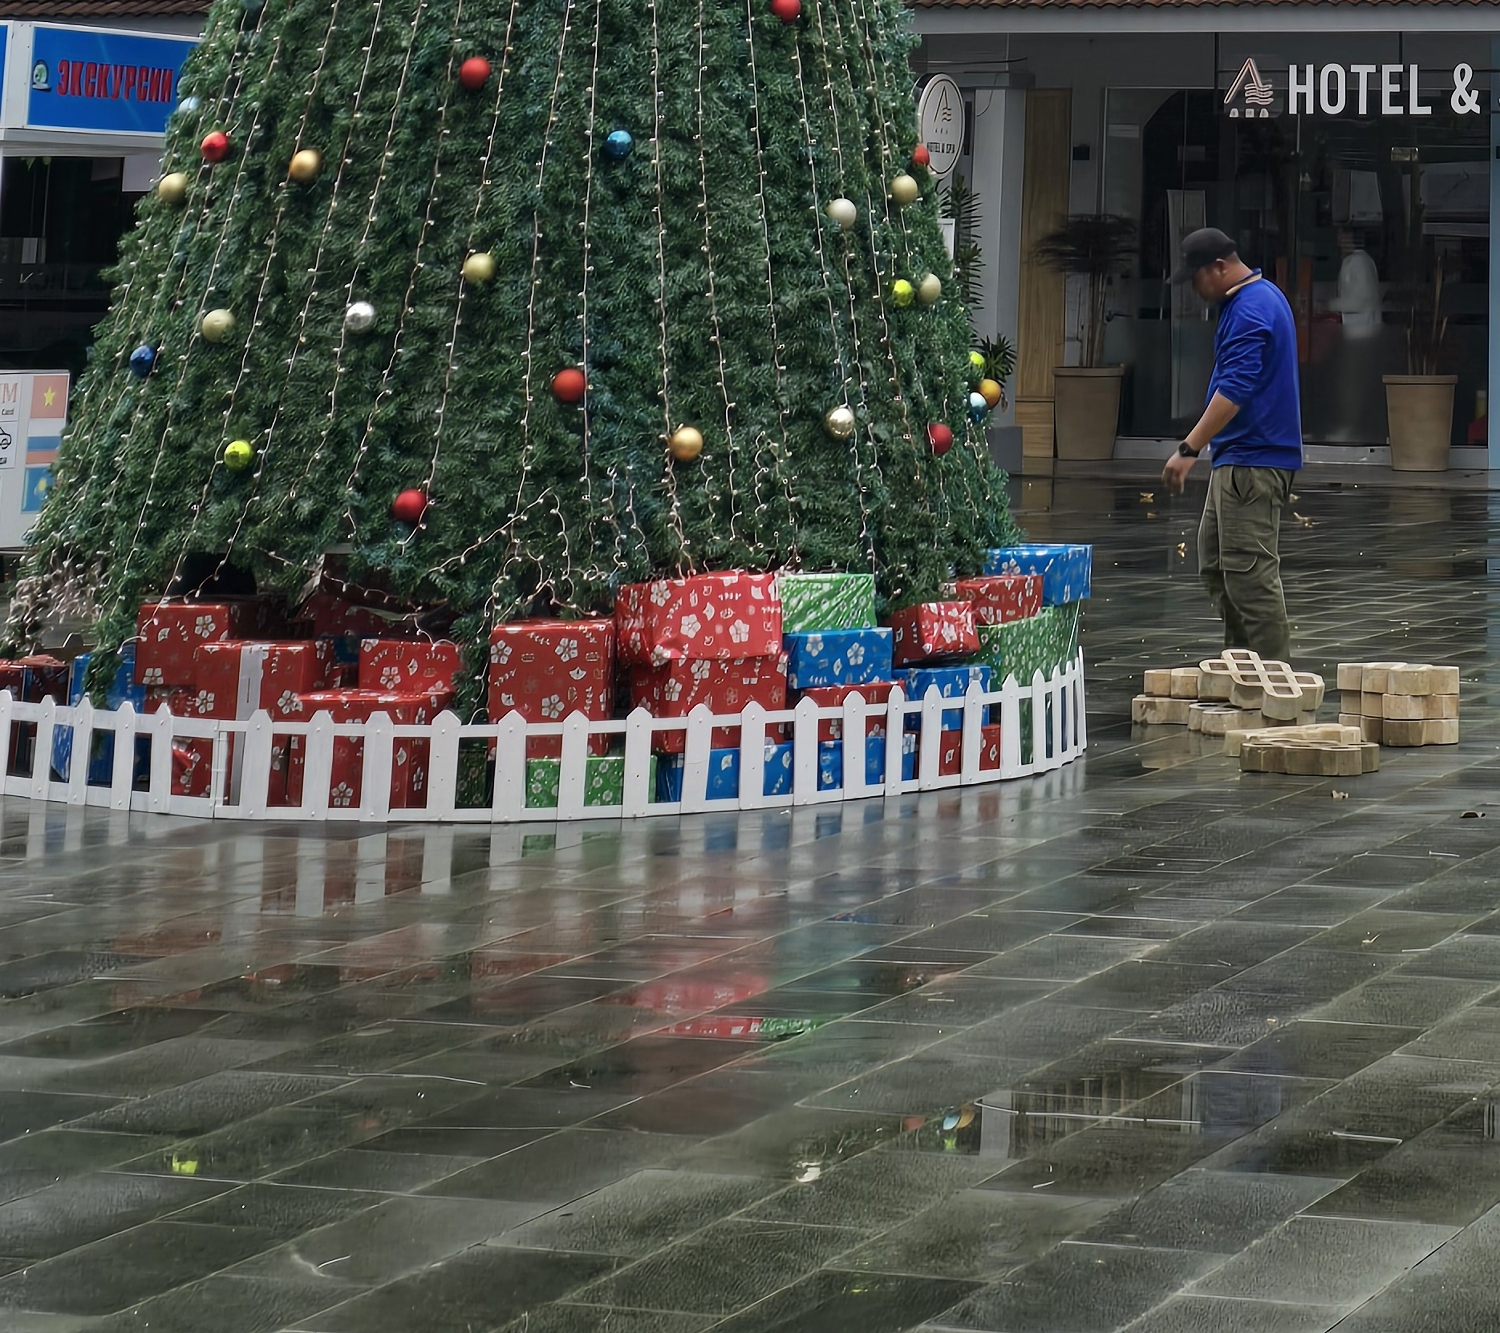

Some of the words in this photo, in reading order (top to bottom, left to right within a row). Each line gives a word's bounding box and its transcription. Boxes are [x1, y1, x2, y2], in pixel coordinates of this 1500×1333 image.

[57, 59, 173, 103] ЭКСКУРСИИ
[1288, 63, 1432, 116] HOTEL
[1450, 63, 1480, 116] &
